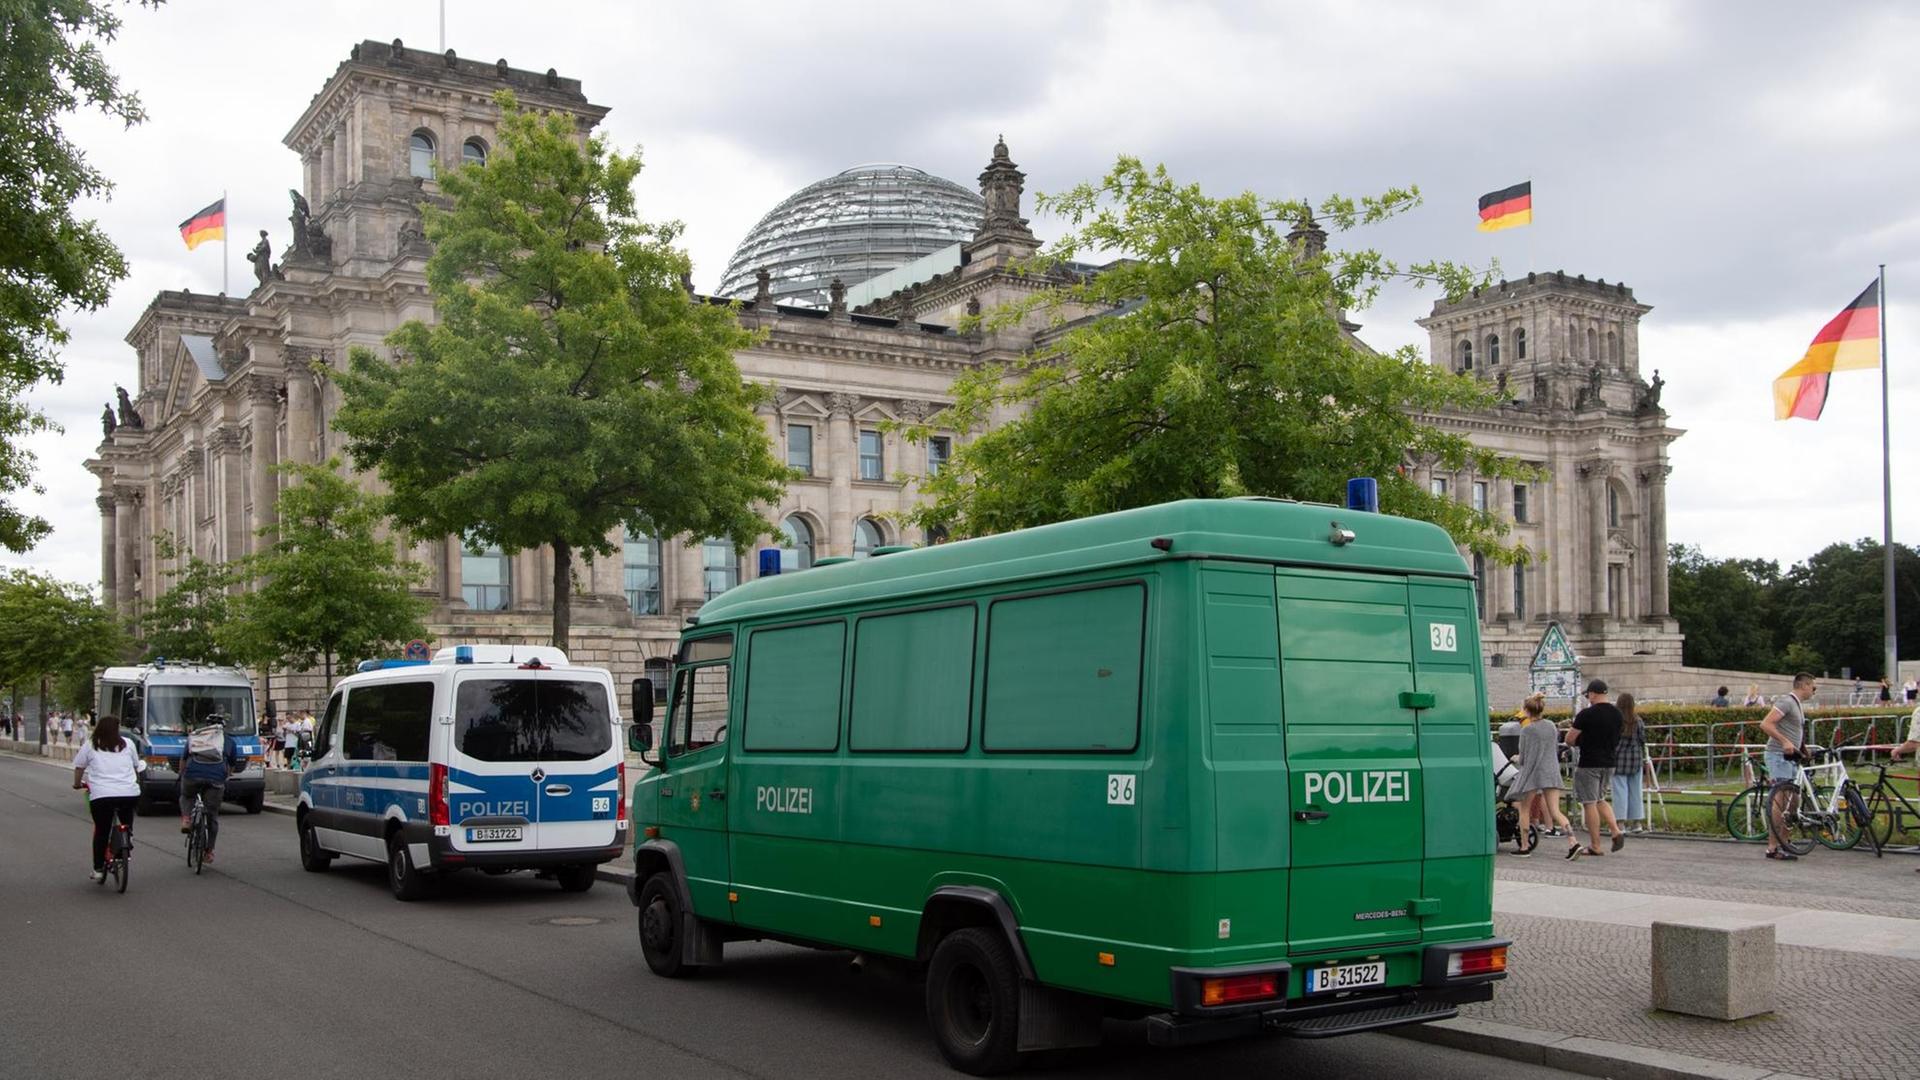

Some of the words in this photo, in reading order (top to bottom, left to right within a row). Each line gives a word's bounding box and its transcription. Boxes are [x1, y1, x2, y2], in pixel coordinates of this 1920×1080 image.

[1432, 626, 1454, 648] 36
[1110, 777, 1132, 801] 36
[1304, 770, 1410, 805] POLIZEI
[459, 800, 529, 817] POLIZEI
[593, 799, 609, 811] 36
[756, 786, 812, 814] POLIZEI
[476, 830, 483, 840] B
[489, 827, 517, 839] 31722
[1320, 970, 1329, 989] B
[1338, 964, 1378, 986] 31522
